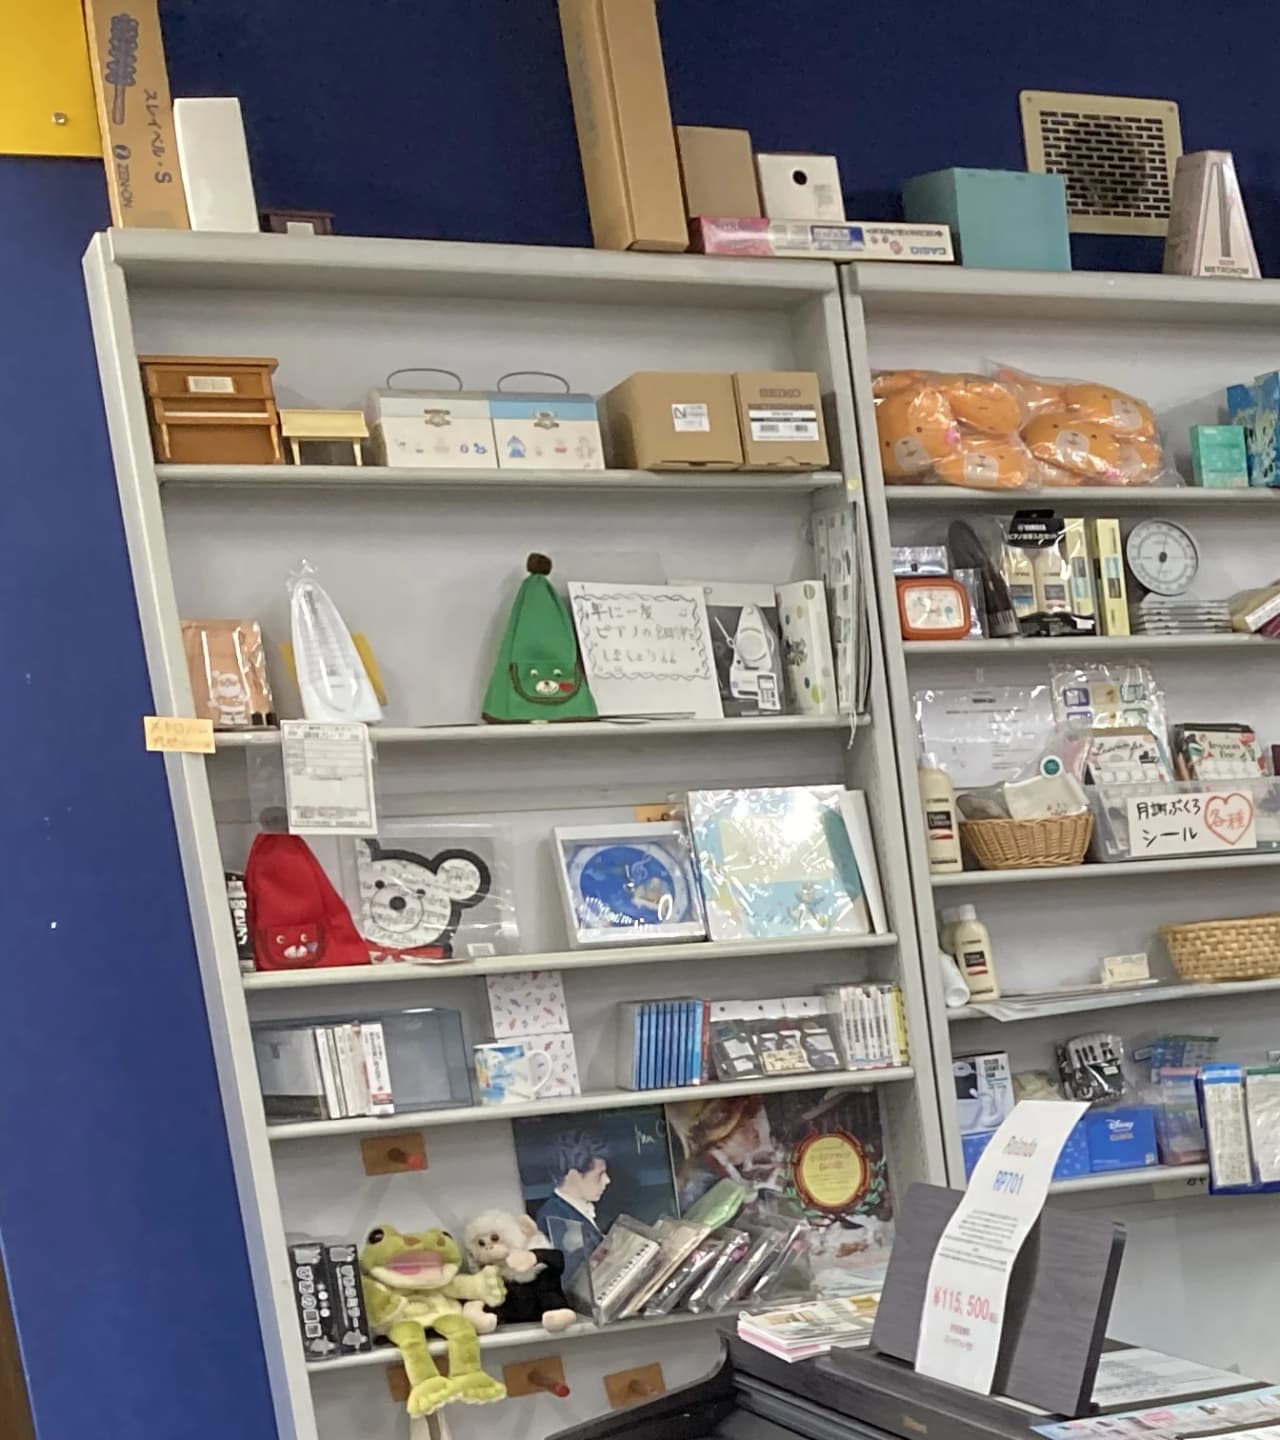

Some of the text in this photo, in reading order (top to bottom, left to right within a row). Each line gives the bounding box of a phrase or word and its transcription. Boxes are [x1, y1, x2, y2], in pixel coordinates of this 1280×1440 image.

[1136, 798, 1201, 820] 月謝ぶくろ
[1142, 826, 1198, 848] シール
[1104, 1118, 1135, 1130] Disney
